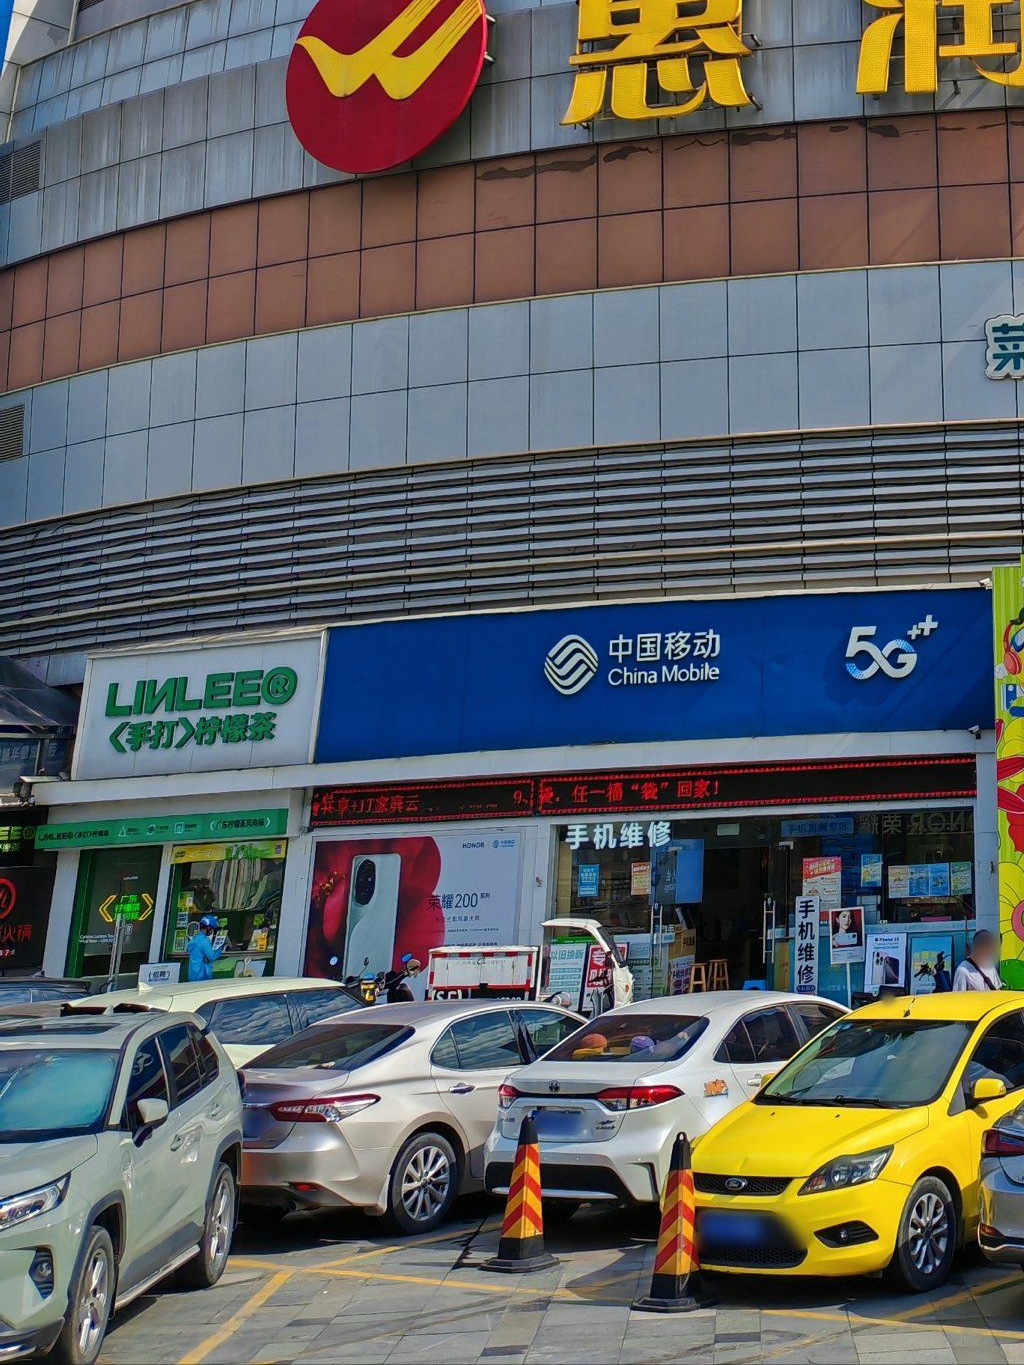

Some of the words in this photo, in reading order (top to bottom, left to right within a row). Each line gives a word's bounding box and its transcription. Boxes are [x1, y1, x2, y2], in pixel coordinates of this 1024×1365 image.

[608, 628, 721, 663] 中国移动
[608, 666, 658, 686] China
[661, 662, 720, 684] Mobile
[462, 841, 485, 849] HONOR
[564, 820, 672, 850] 手机维修
[428, 893, 478, 910] 荣耀200
[797, 899, 815, 984] 手机维修
